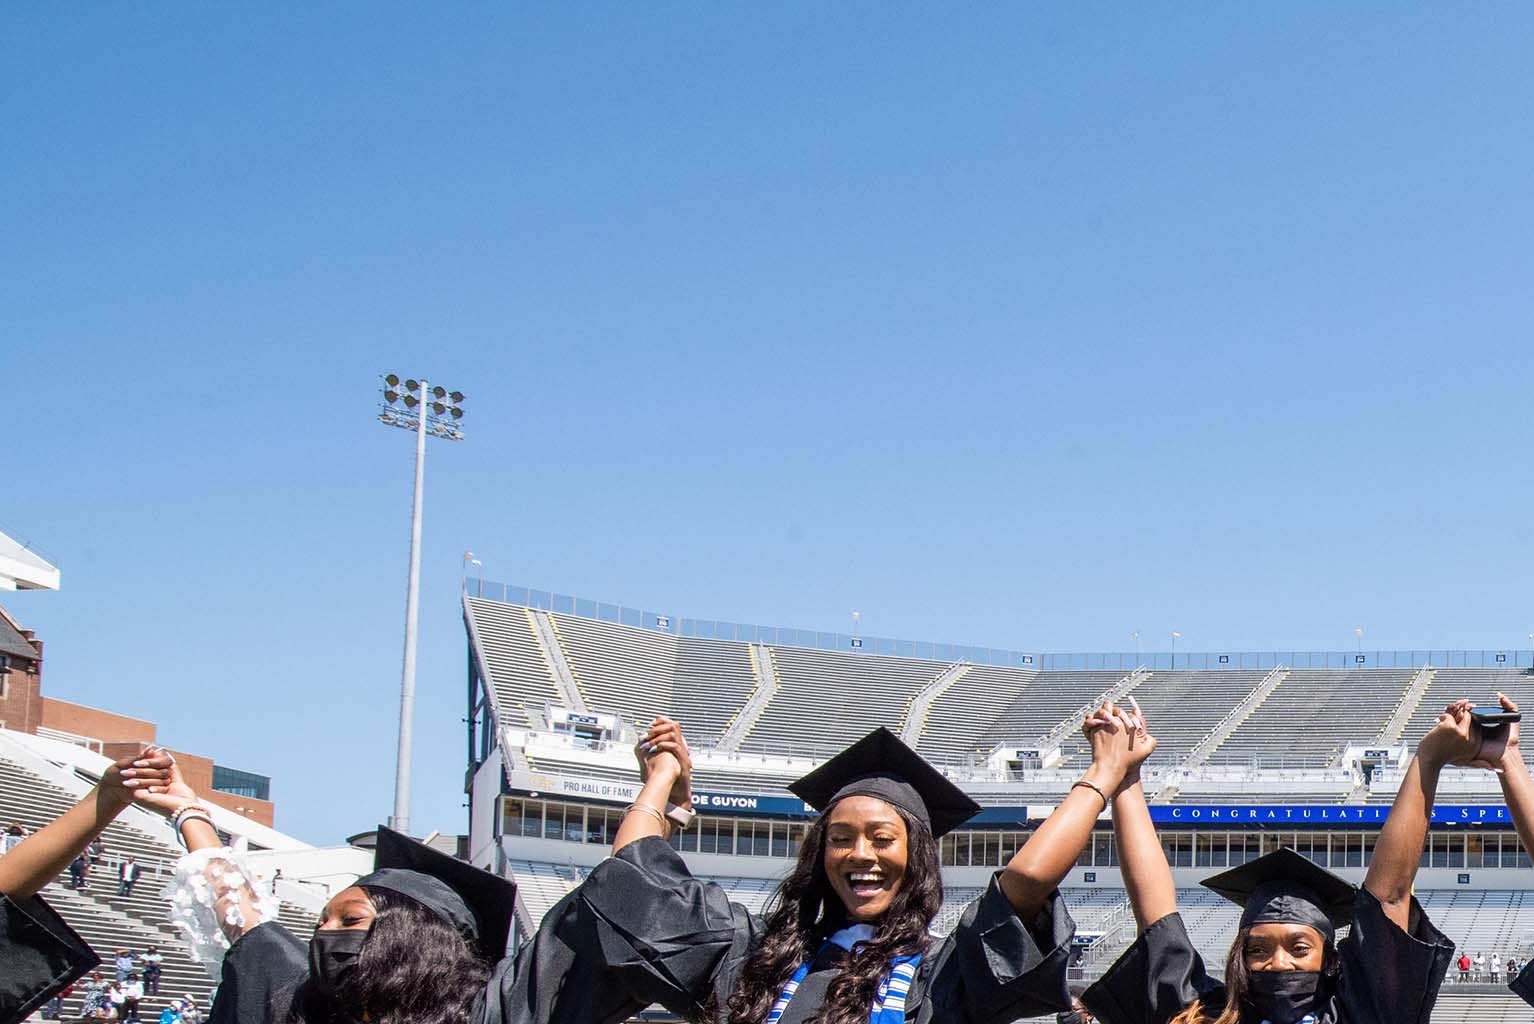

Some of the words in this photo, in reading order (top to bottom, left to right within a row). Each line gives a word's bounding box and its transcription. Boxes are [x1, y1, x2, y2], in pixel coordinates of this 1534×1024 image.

[564, 781, 580, 792] PRO
[581, 783, 600, 794] HALL
[601, 786, 612, 795] OF
[613, 788, 633, 798] FAME
[691, 795, 709, 805] OE
[711, 797, 757, 808] GUYON
[1172, 808, 1436, 818] CONGRATULATIS
